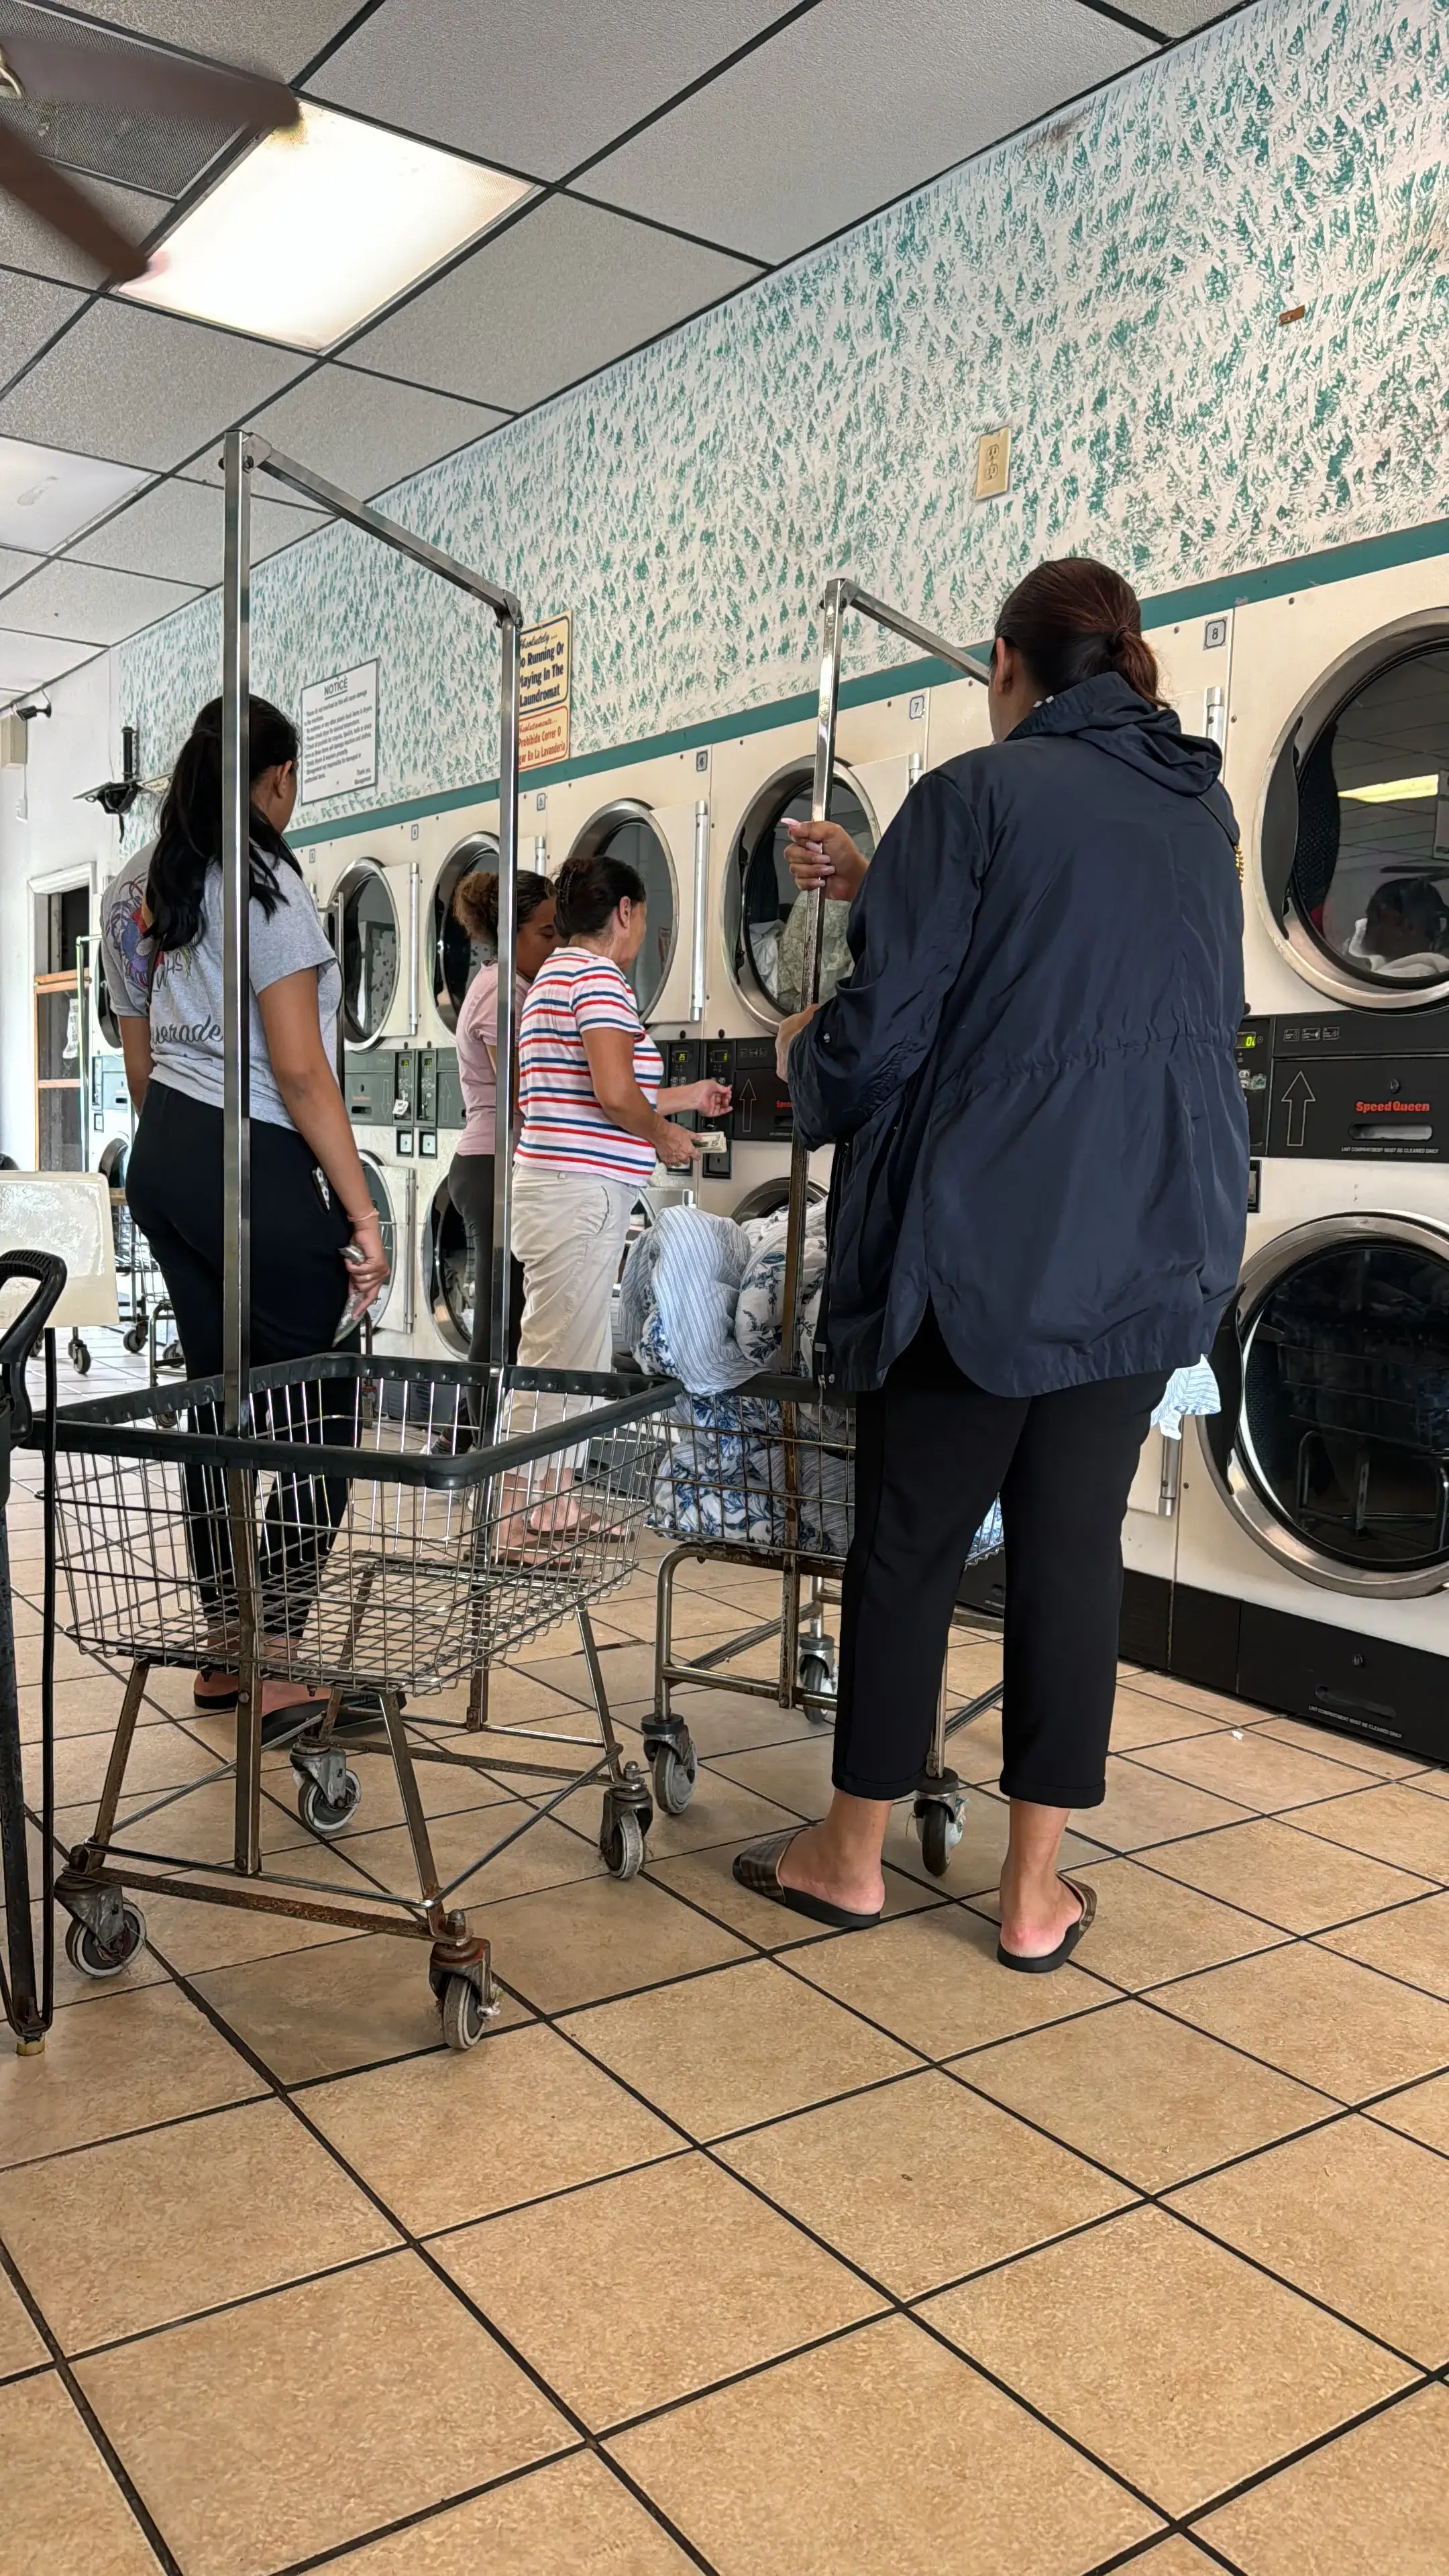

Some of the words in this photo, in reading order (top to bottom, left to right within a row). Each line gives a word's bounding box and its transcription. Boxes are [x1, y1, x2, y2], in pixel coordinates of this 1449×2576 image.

[1212, 627, 1219, 640] 8
[527, 646, 555, 665] Running
[556, 641, 564, 655] Or
[520, 669, 541, 690] laying
[543, 667, 550, 681] In
[552, 663, 564, 678] The
[325, 677, 348, 696] NOTICE
[520, 683, 560, 708] Laundromat
[914, 702, 920, 712] 7
[542, 729, 557, 742] Correr
[557, 725, 561, 737] O
[1356, 1100, 1392, 1113] Speed
[1393, 1100, 1430, 1112] Queen
